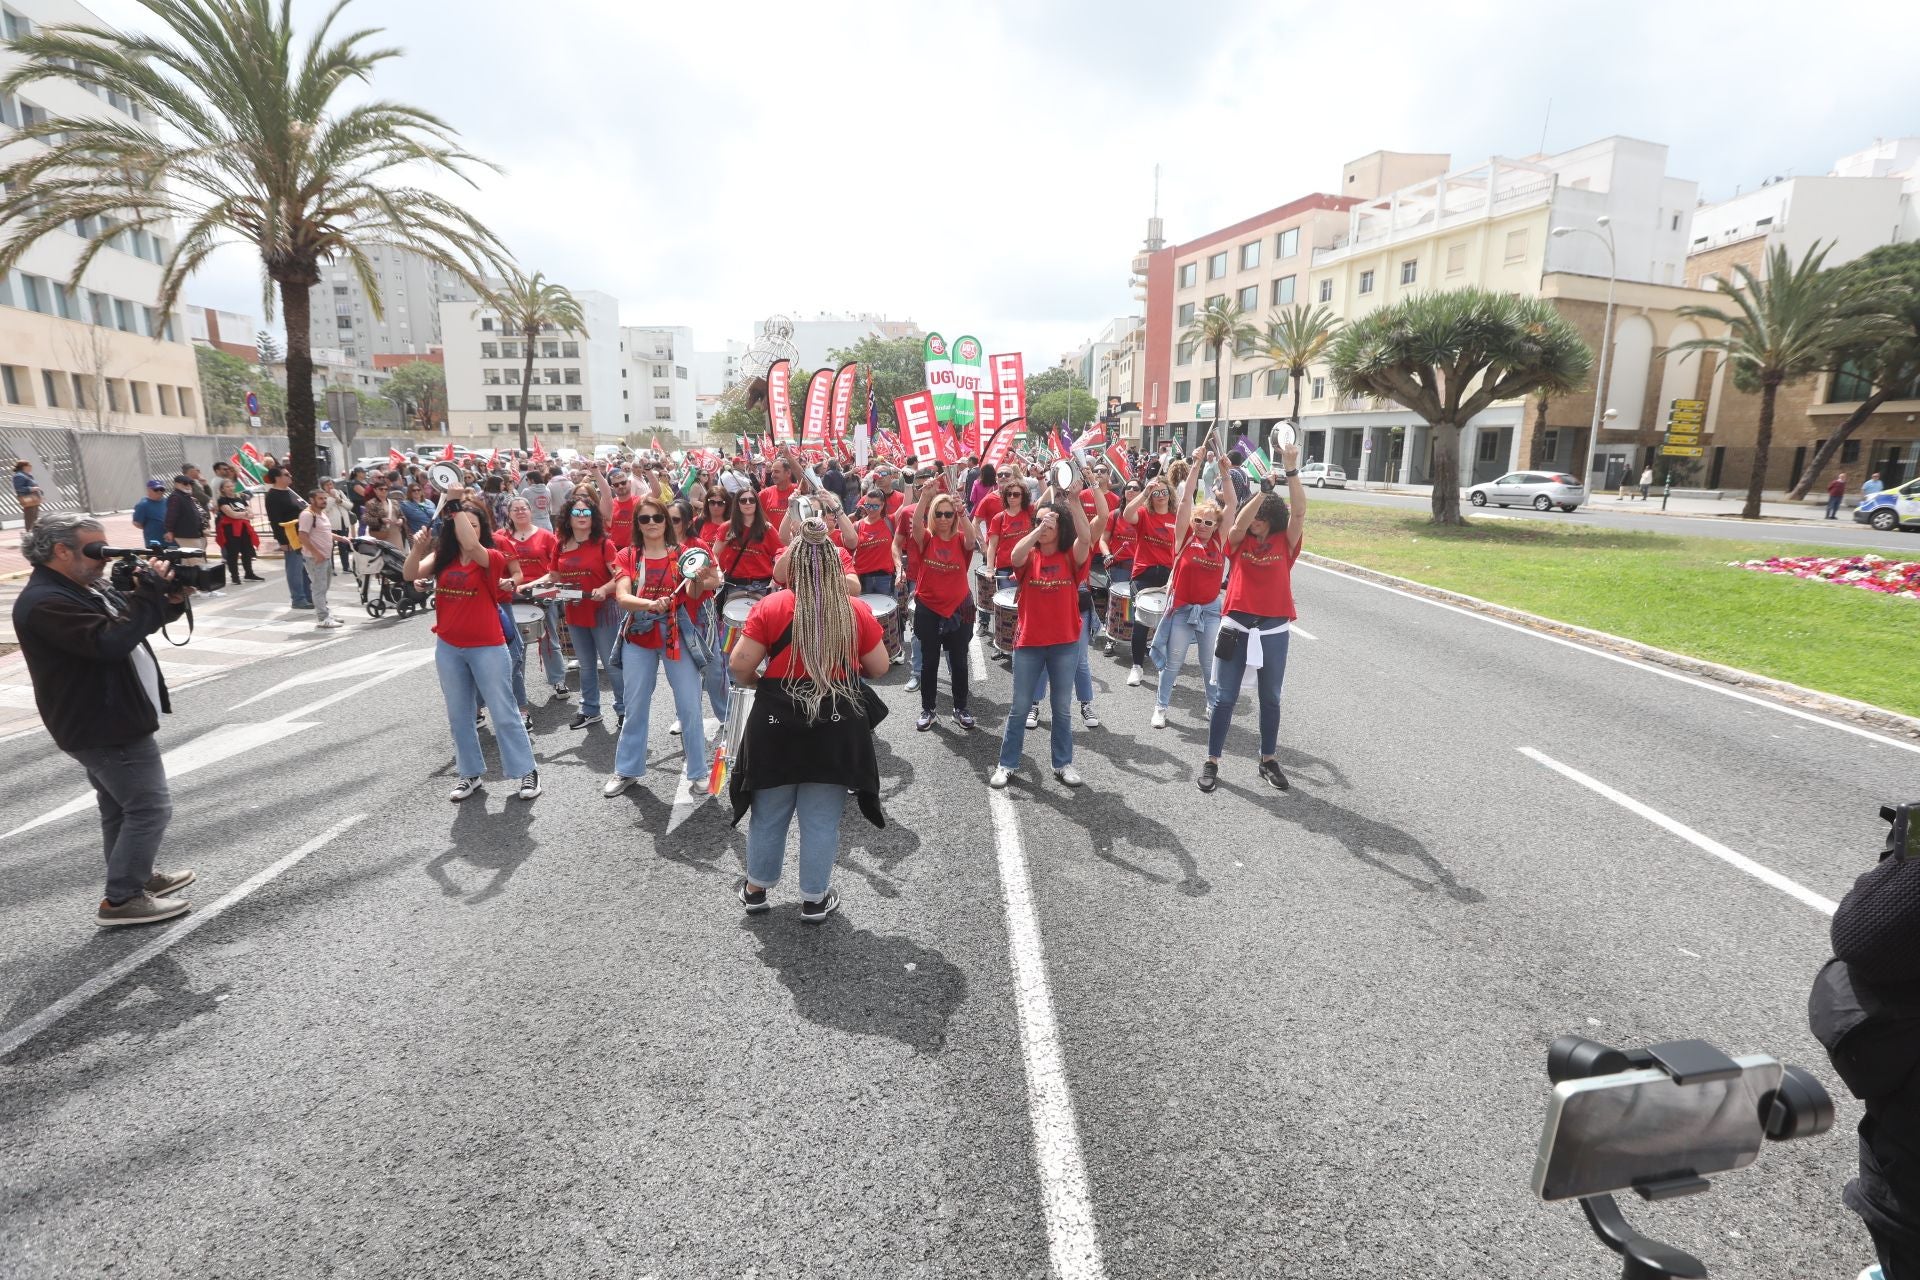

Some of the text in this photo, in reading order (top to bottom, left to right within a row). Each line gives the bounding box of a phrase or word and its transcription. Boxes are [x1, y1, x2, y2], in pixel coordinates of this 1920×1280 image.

[771, 370, 790, 433] CCOO
[808, 376, 827, 432] CCOO
[834, 373, 851, 431] CCOO
[956, 375, 980, 390] UGT
